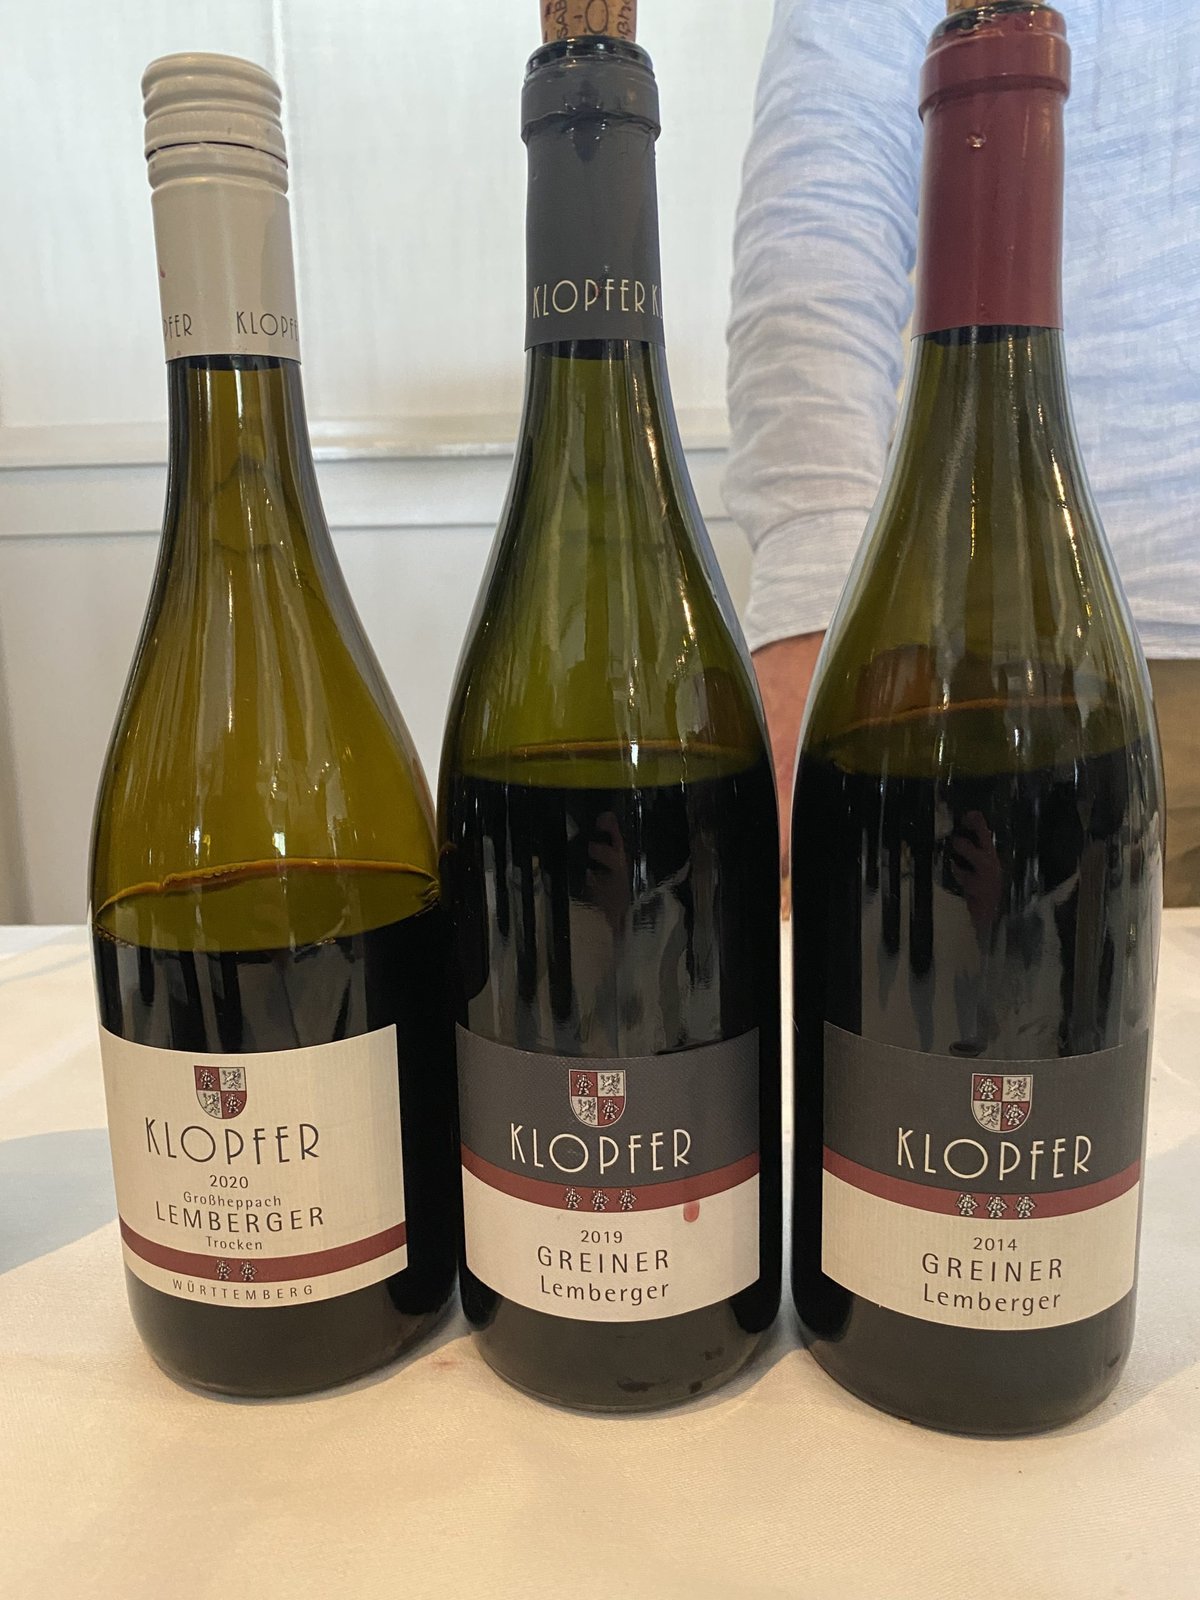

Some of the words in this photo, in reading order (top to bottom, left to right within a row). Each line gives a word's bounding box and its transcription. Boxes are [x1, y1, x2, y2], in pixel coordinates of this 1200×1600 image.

[533, 279, 646, 319] KLOPFER
[145, 1116, 320, 1165] KLOPFER
[510, 1123, 692, 1175] KLOPFER
[897, 1127, 1092, 1181] KLOPFER
[209, 1174, 249, 1189] 2020
[183, 1191, 282, 1210] Großheppach
[155, 1201, 324, 1233] LEMBERGER
[205, 1235, 263, 1251] Trocken
[580, 1230, 623, 1244] 2019
[972, 1237, 1018, 1251] 2014
[537, 1246, 669, 1274] GREINER
[921, 1253, 1063, 1283] GREINER
[172, 1278, 313, 1301] WÜRTTEMBERG
[540, 1275, 669, 1306] Lemberger
[923, 1283, 1061, 1316] Lemberger
